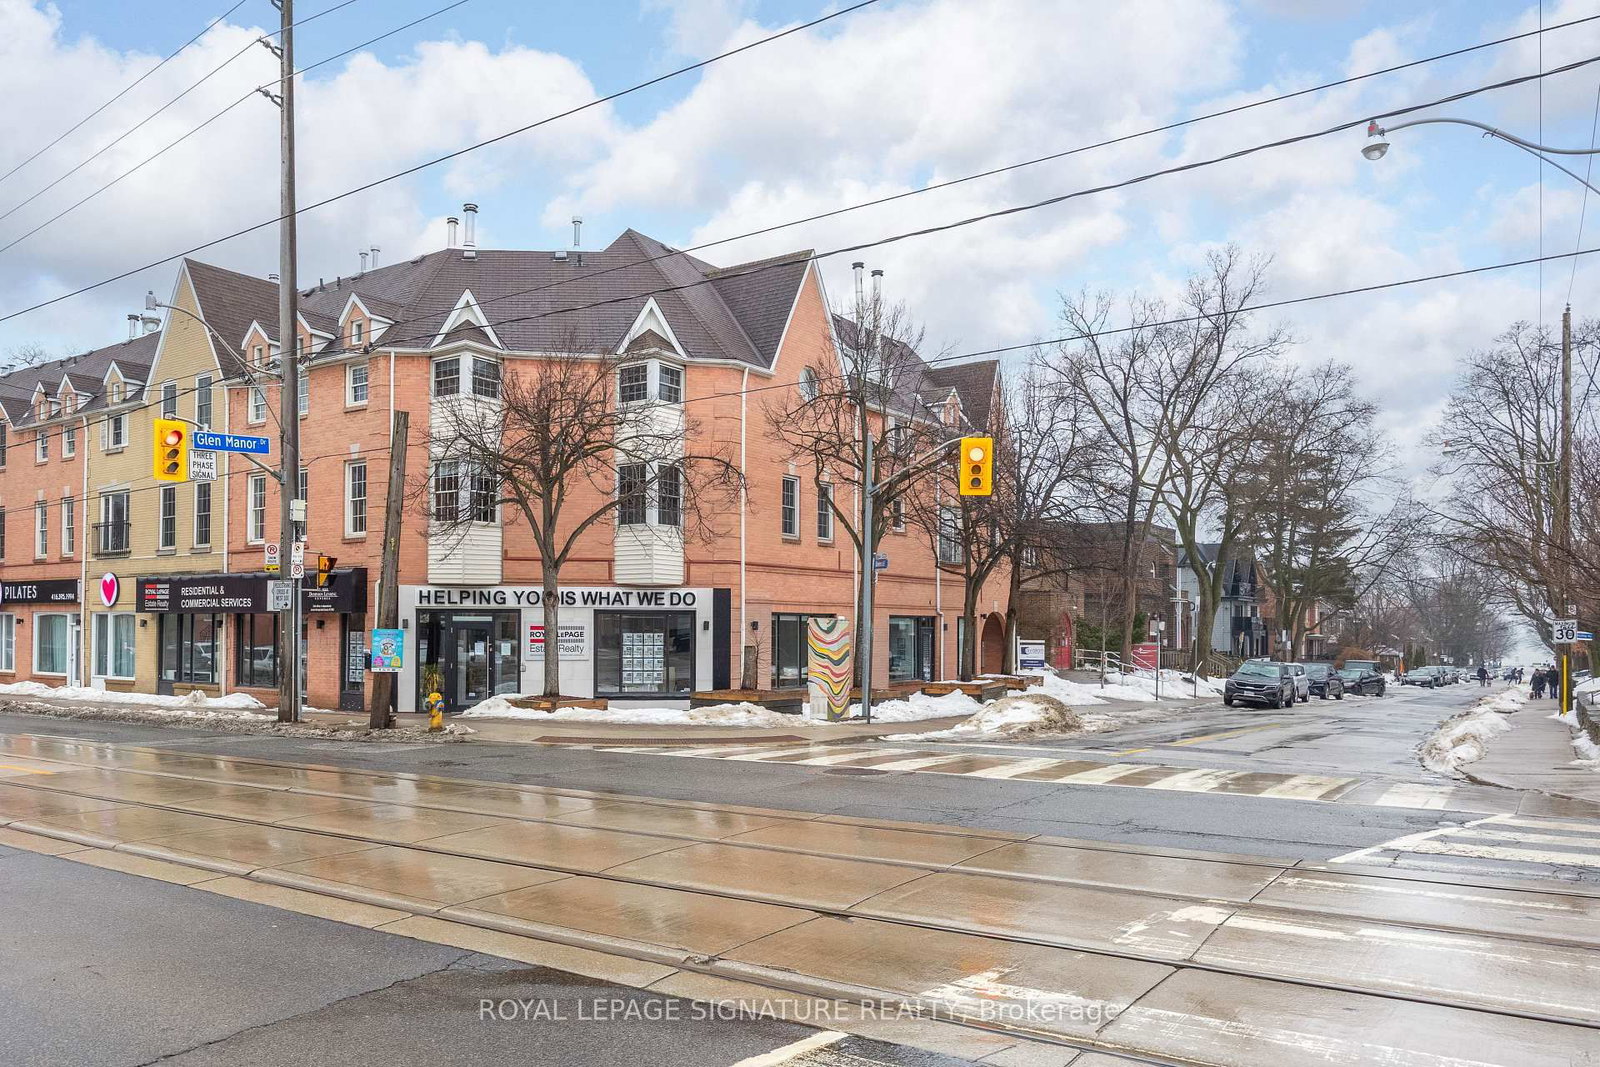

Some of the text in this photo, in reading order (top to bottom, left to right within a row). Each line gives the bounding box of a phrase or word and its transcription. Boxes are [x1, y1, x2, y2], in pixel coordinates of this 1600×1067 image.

[197, 433, 221, 447] Glen
[225, 436, 257, 449] Manor
[193, 451, 213, 460] THREE
[192, 461, 214, 470] PHASE
[192, 471, 215, 479] SIGNAL
[4, 585, 37, 599] PILATES
[181, 585, 225, 596] RESIDENTIAL &
[181, 598, 252, 608] COMMERCIAL SERVICES
[419, 590, 696, 606] HELPING YO IS WHAT WE DO
[144, 599, 169, 609] Estate Realty
[1555, 629, 1575, 640] 30
[559, 644, 585, 654] Realty
